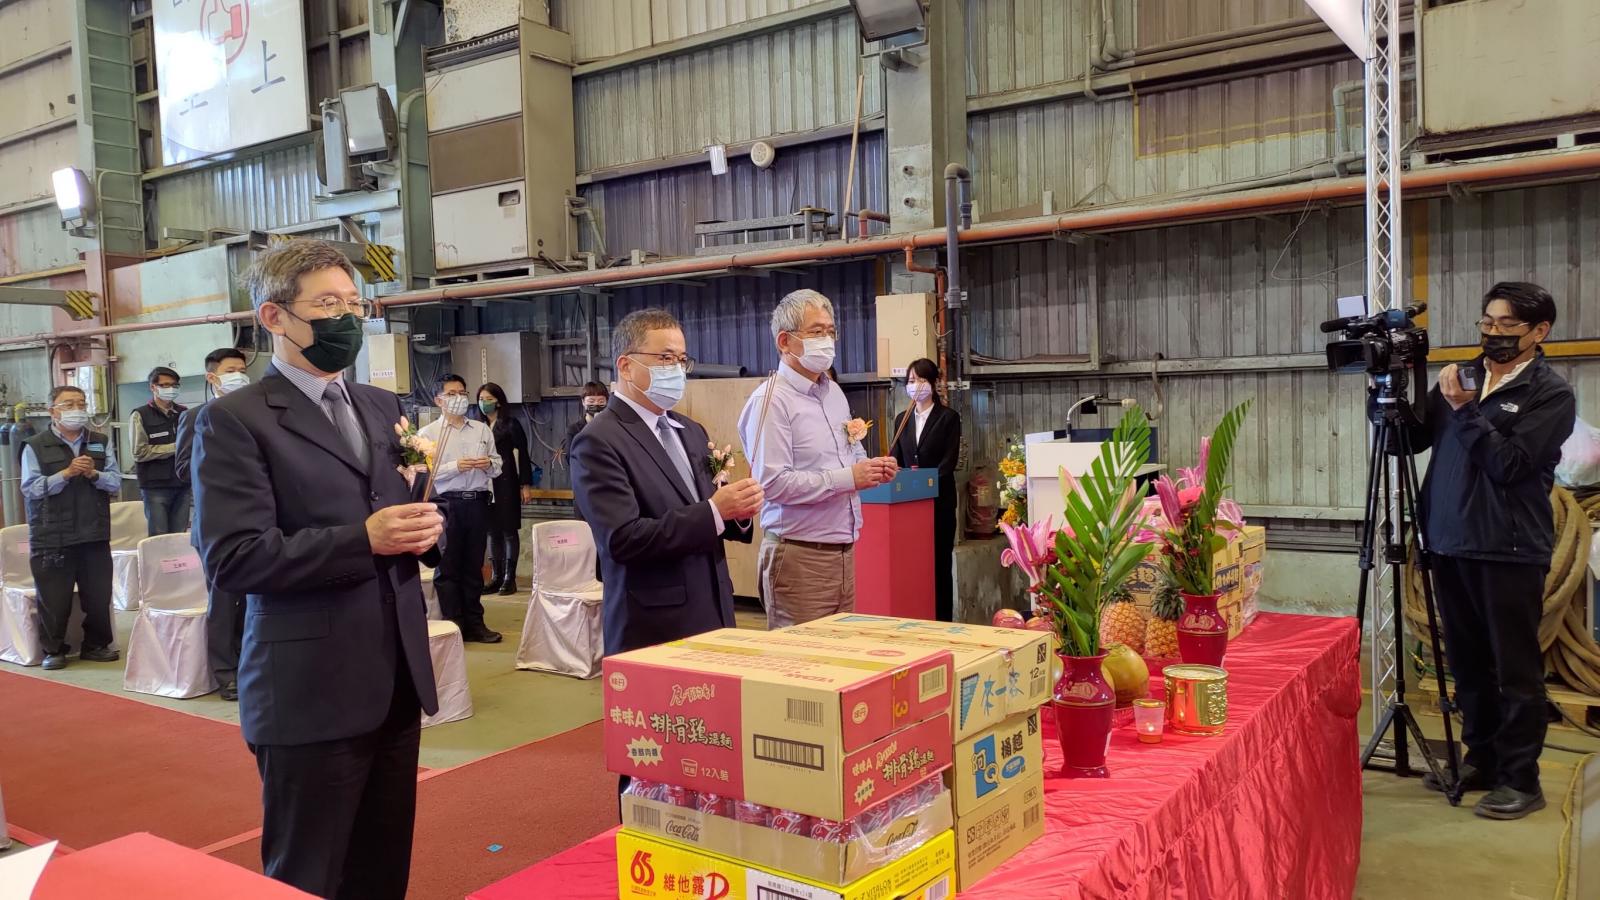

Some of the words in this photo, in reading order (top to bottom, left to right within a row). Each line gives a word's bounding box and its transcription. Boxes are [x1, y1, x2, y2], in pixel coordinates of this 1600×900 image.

[251, 40, 286, 94] 上
[912, 324, 920, 337] 5
[609, 706, 648, 730] 味味A
[630, 850, 655, 887] 65
